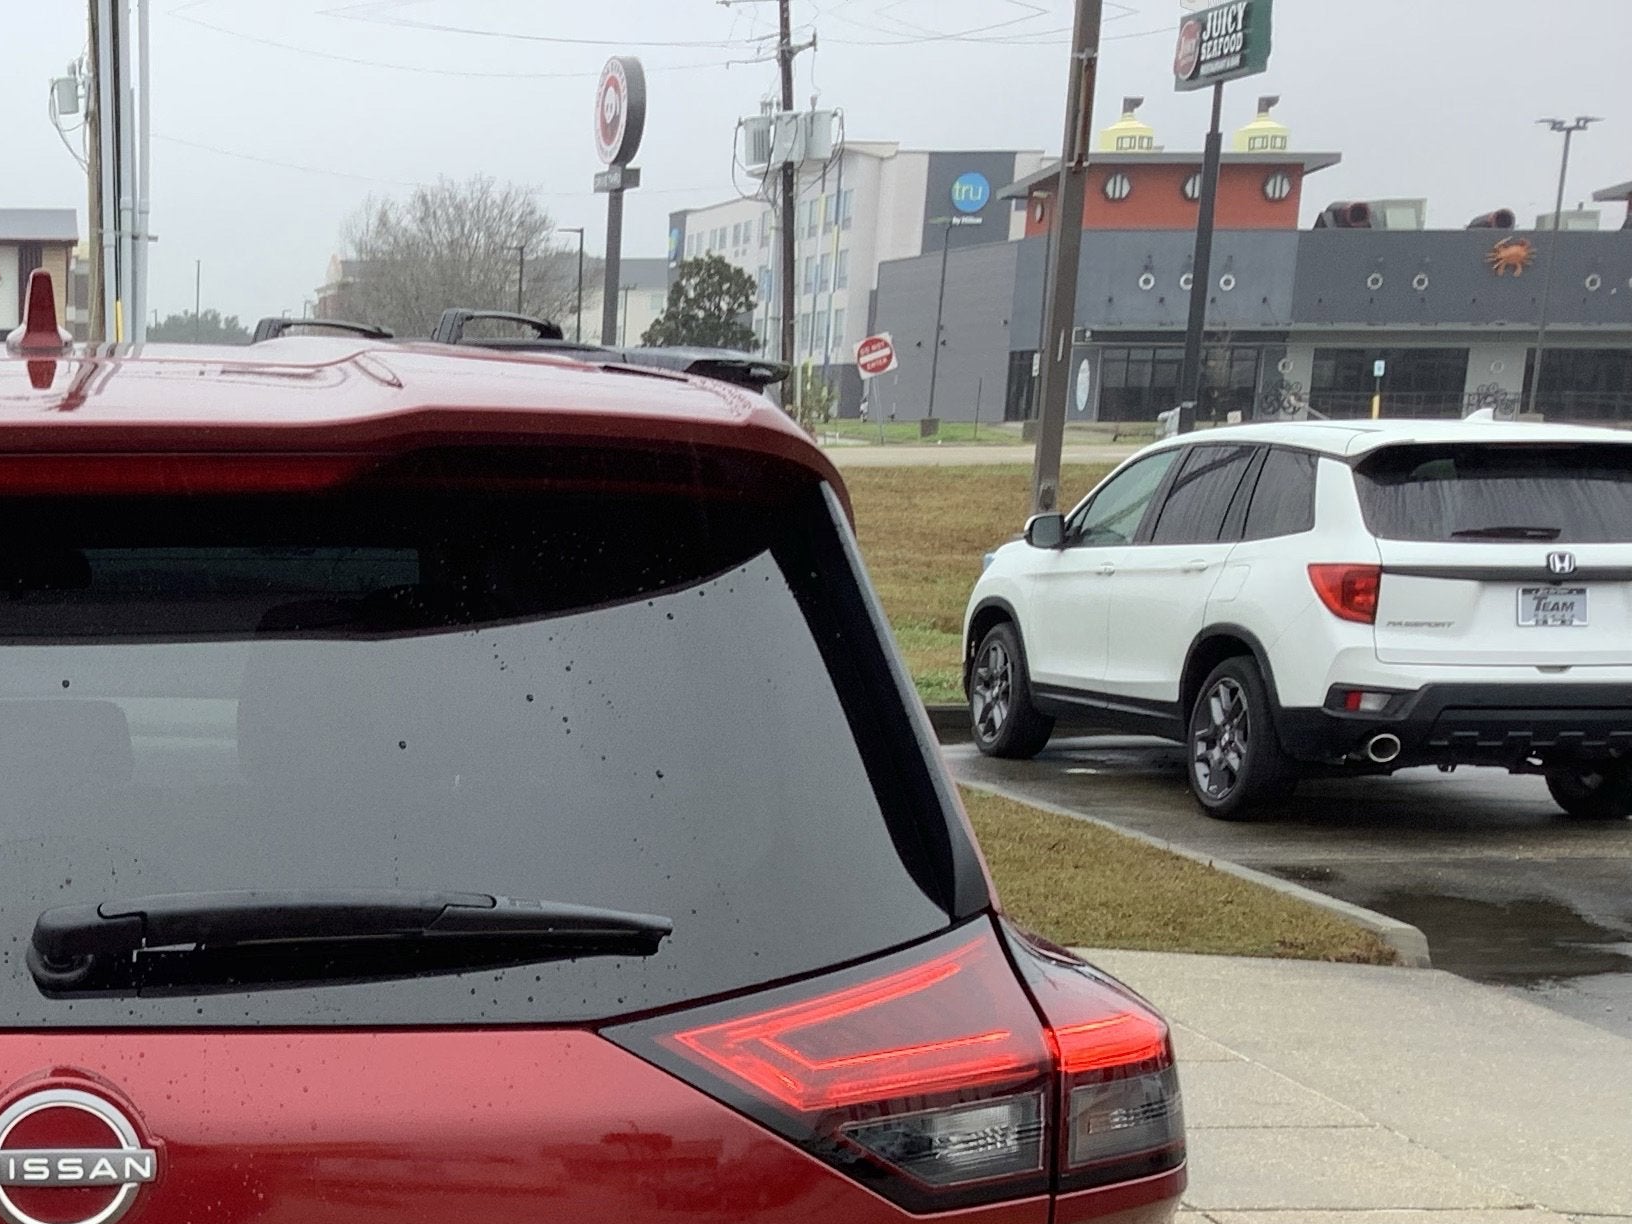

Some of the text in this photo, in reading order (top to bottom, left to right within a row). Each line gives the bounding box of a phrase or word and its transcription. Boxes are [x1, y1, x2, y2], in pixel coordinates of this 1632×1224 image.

[1202, 1, 1247, 40] JUICY
[1200, 31, 1243, 61] SEAFOOD
[953, 181, 983, 201] tru
[1533, 594, 1575, 612] TEAM
